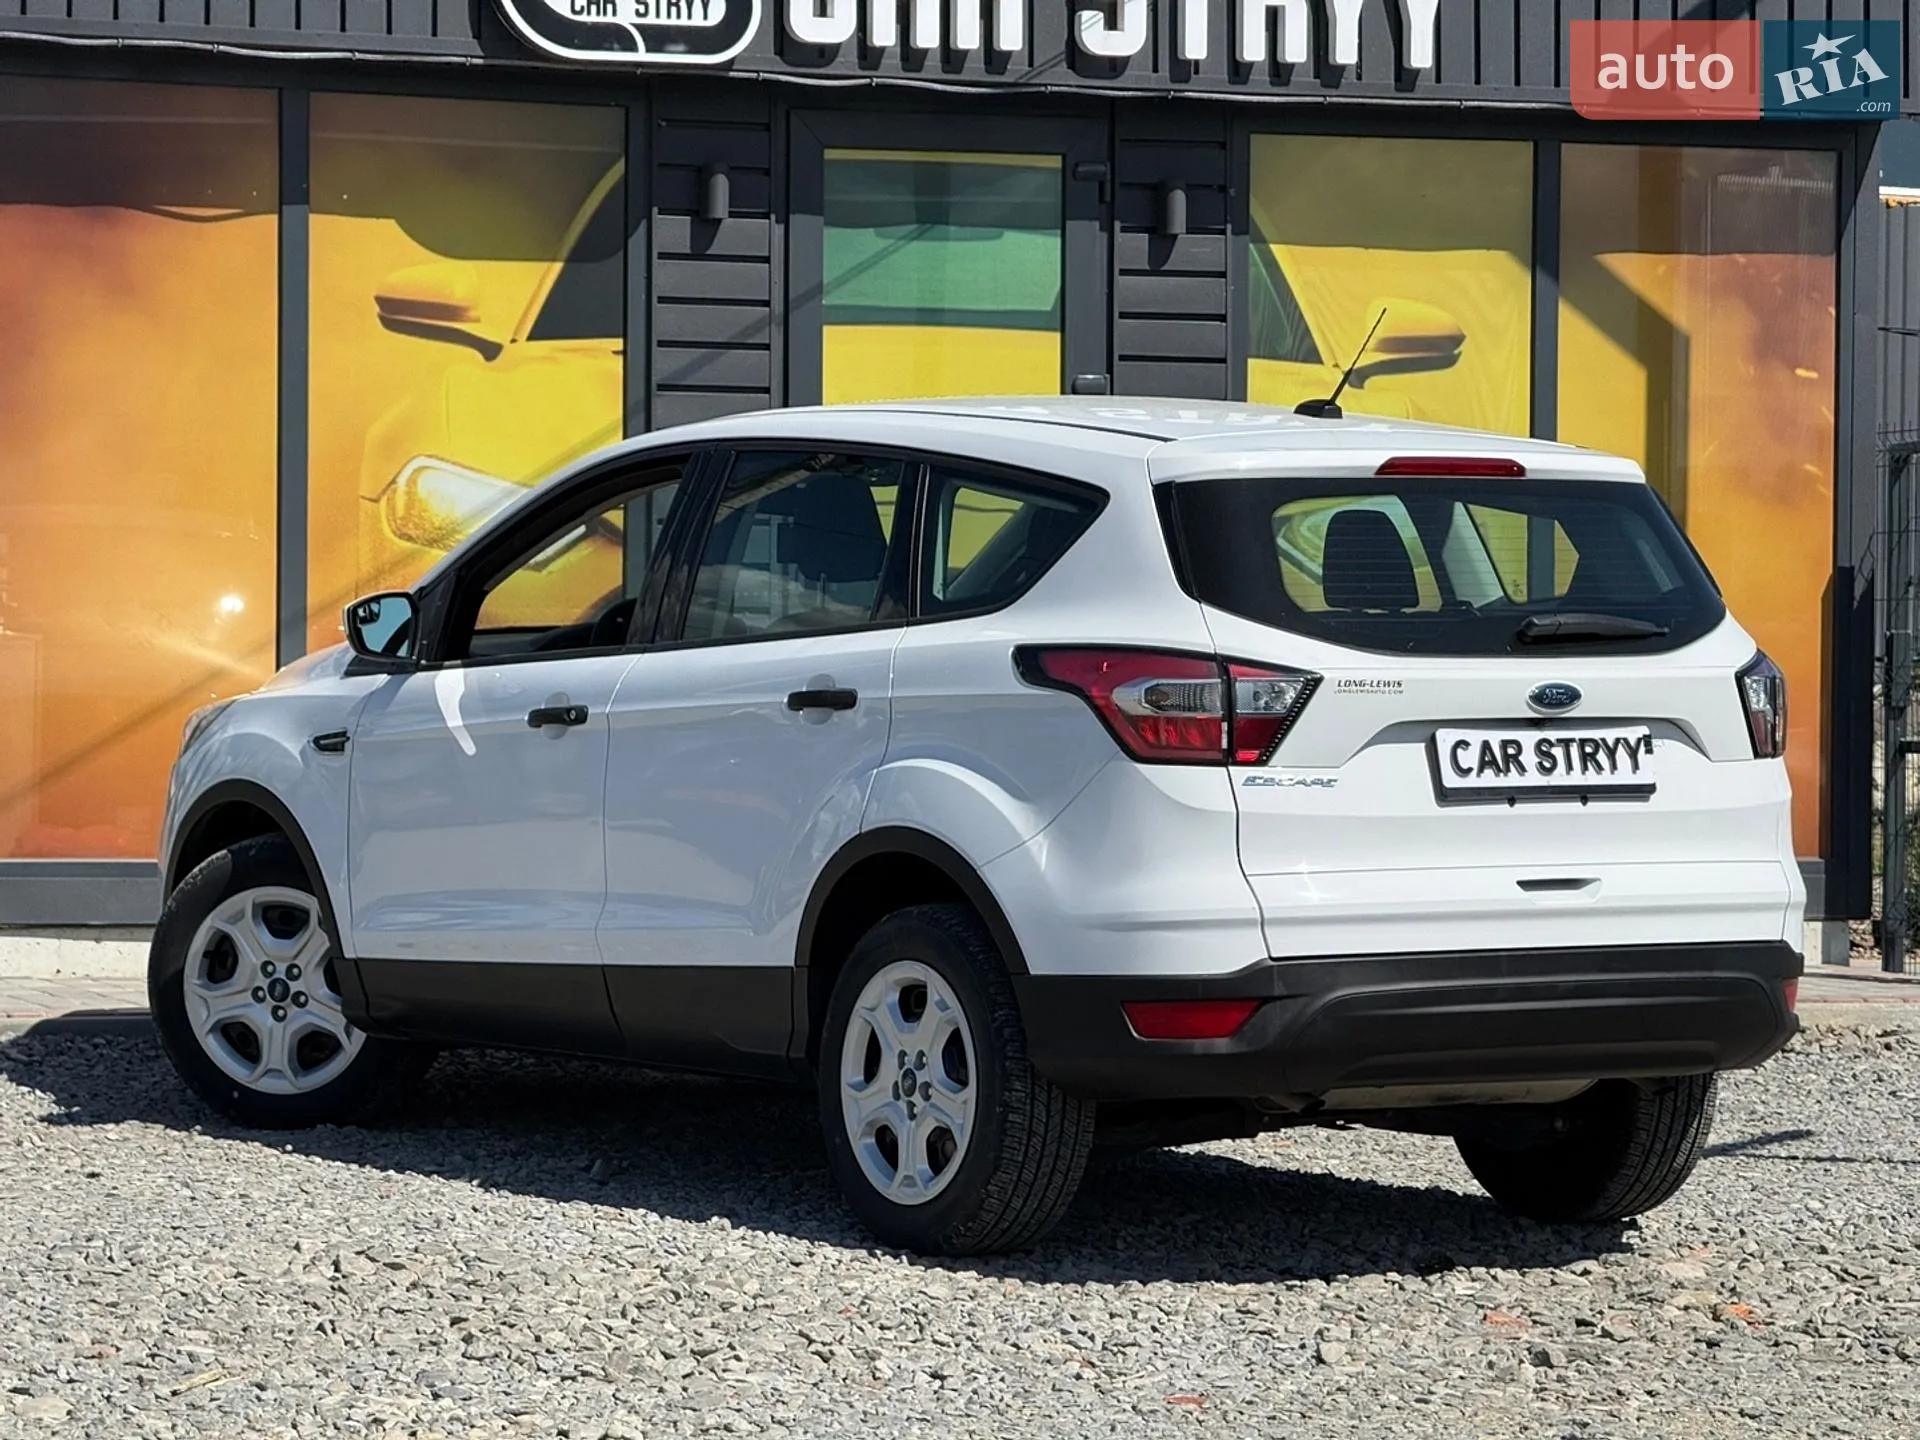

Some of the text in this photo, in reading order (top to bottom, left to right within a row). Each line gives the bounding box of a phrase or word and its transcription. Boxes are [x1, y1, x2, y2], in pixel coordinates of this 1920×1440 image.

[1336, 679, 1404, 688] LONG-LEWIS
[1450, 737, 1645, 778] CAR STRYY
